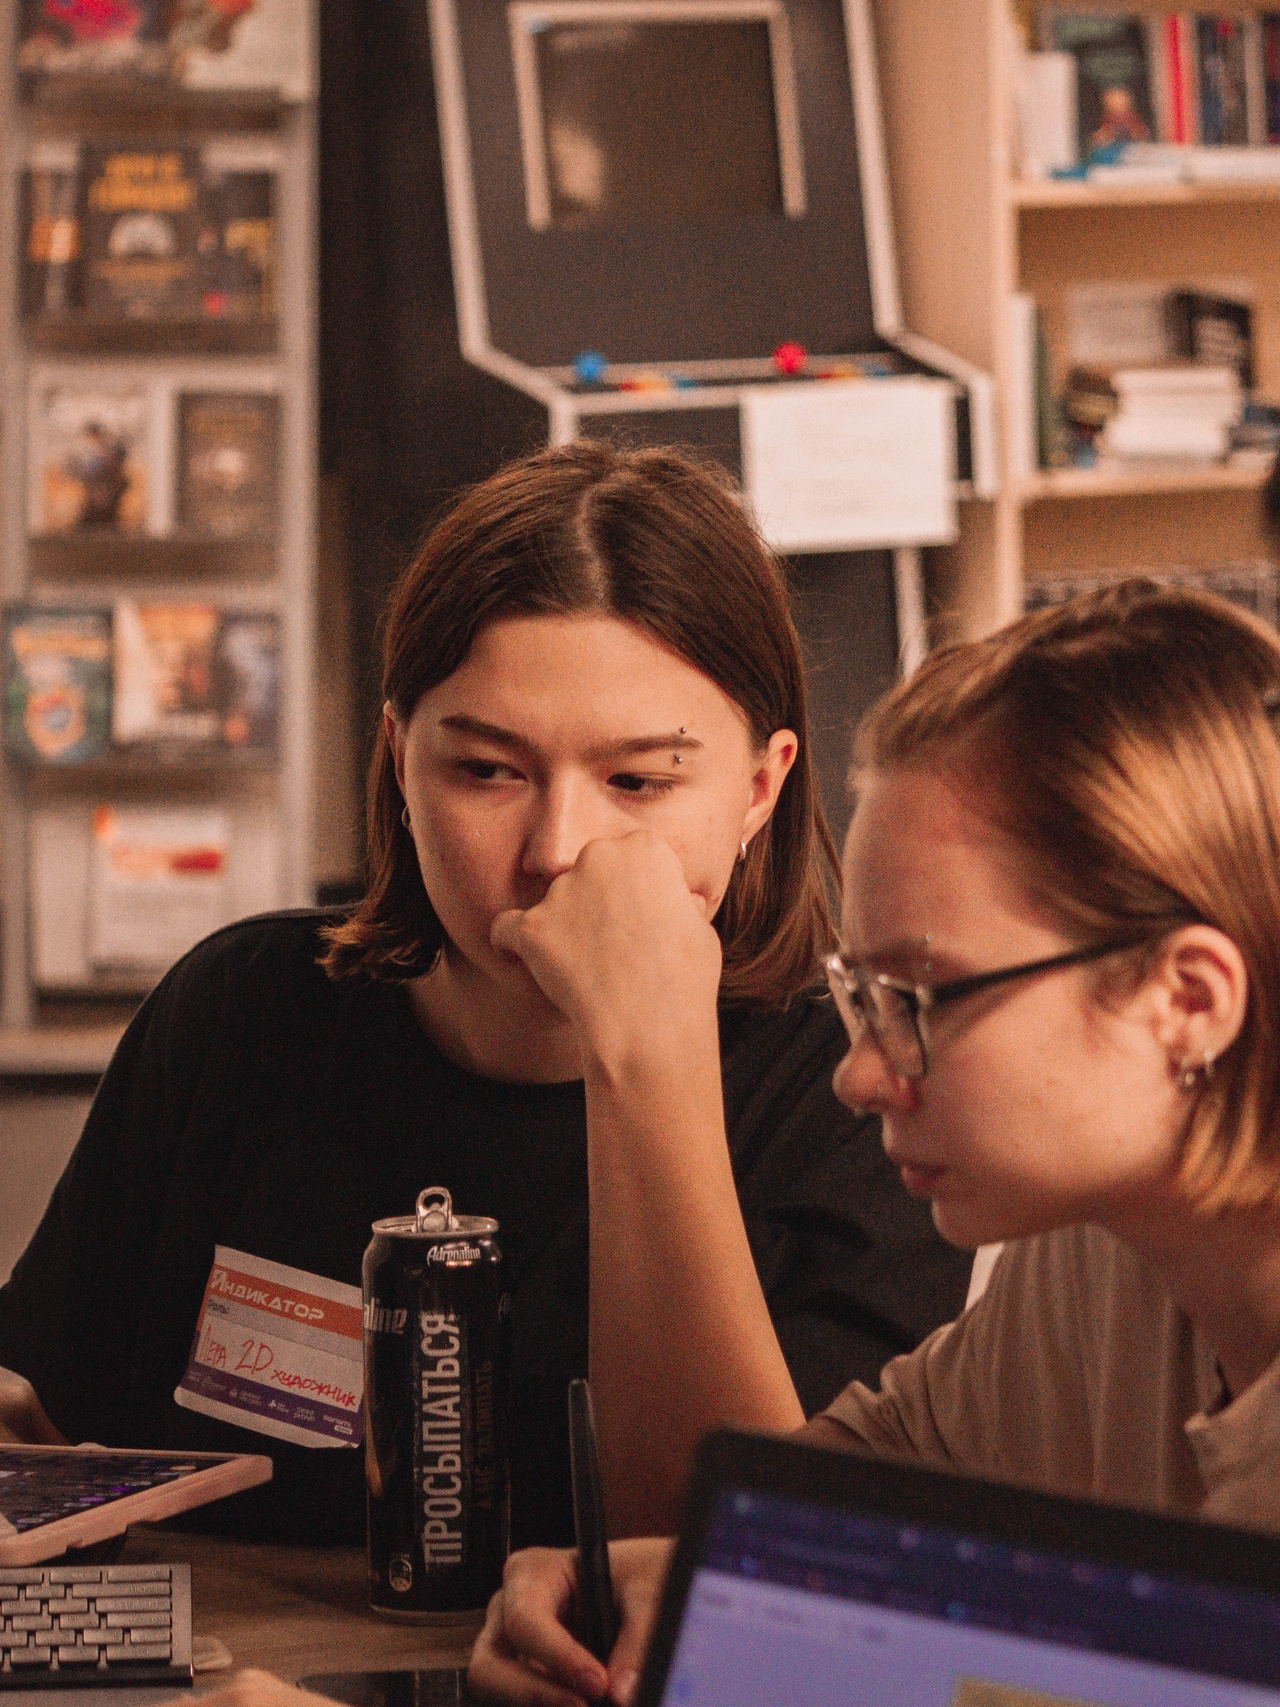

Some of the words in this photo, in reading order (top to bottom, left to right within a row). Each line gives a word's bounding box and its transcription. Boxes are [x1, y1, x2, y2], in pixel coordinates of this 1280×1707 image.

[426, 1244, 482, 1267] Adrenaline
[235, 1338, 275, 1375] 2D
[420, 1310, 463, 1566] ПРОСЫПАТЬСЯ
